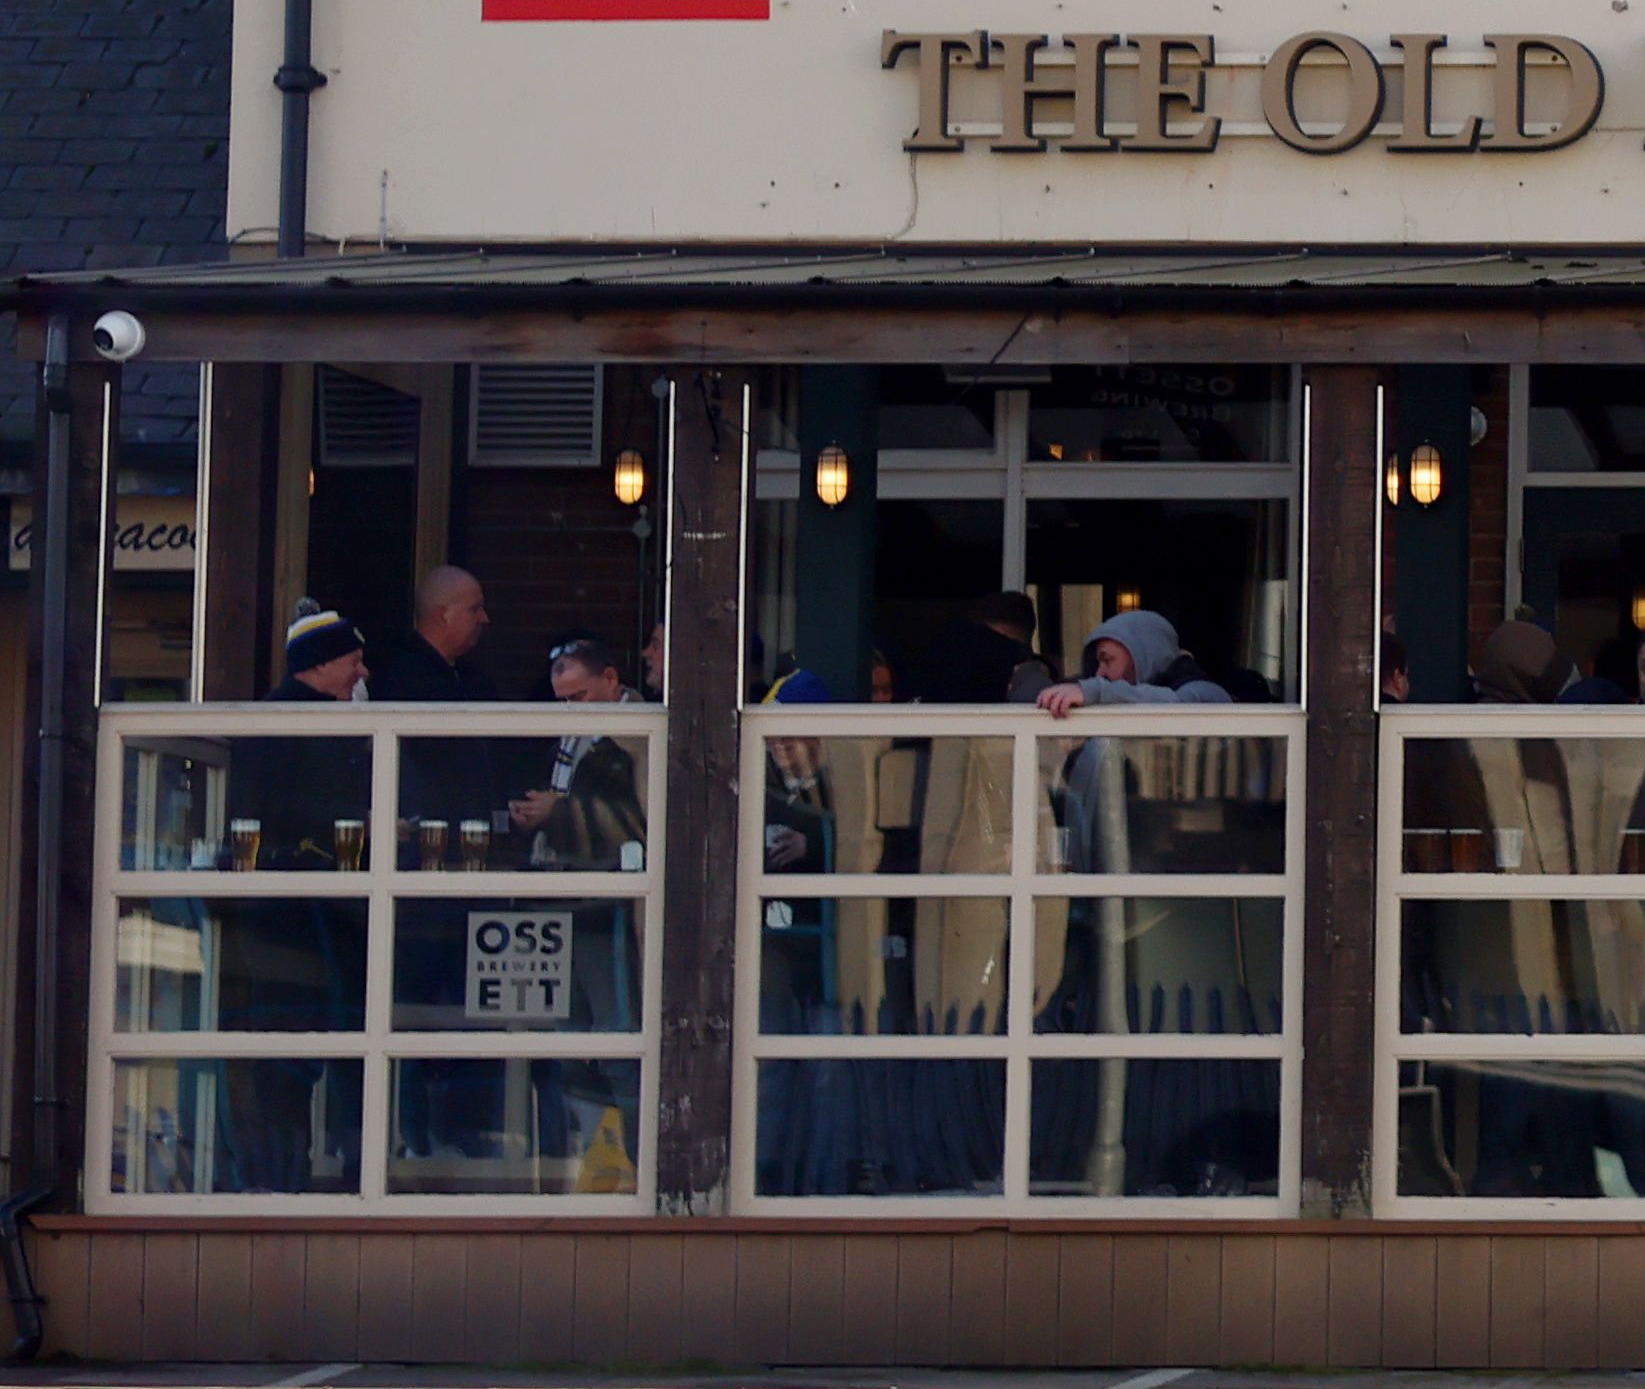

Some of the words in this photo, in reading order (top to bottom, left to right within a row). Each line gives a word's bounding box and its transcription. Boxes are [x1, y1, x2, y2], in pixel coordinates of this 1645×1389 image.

[881, 28, 1222, 154] THE
[1260, 29, 1607, 155] OLD
[475, 920, 564, 955] OSS
[479, 978, 562, 1012] ETT
